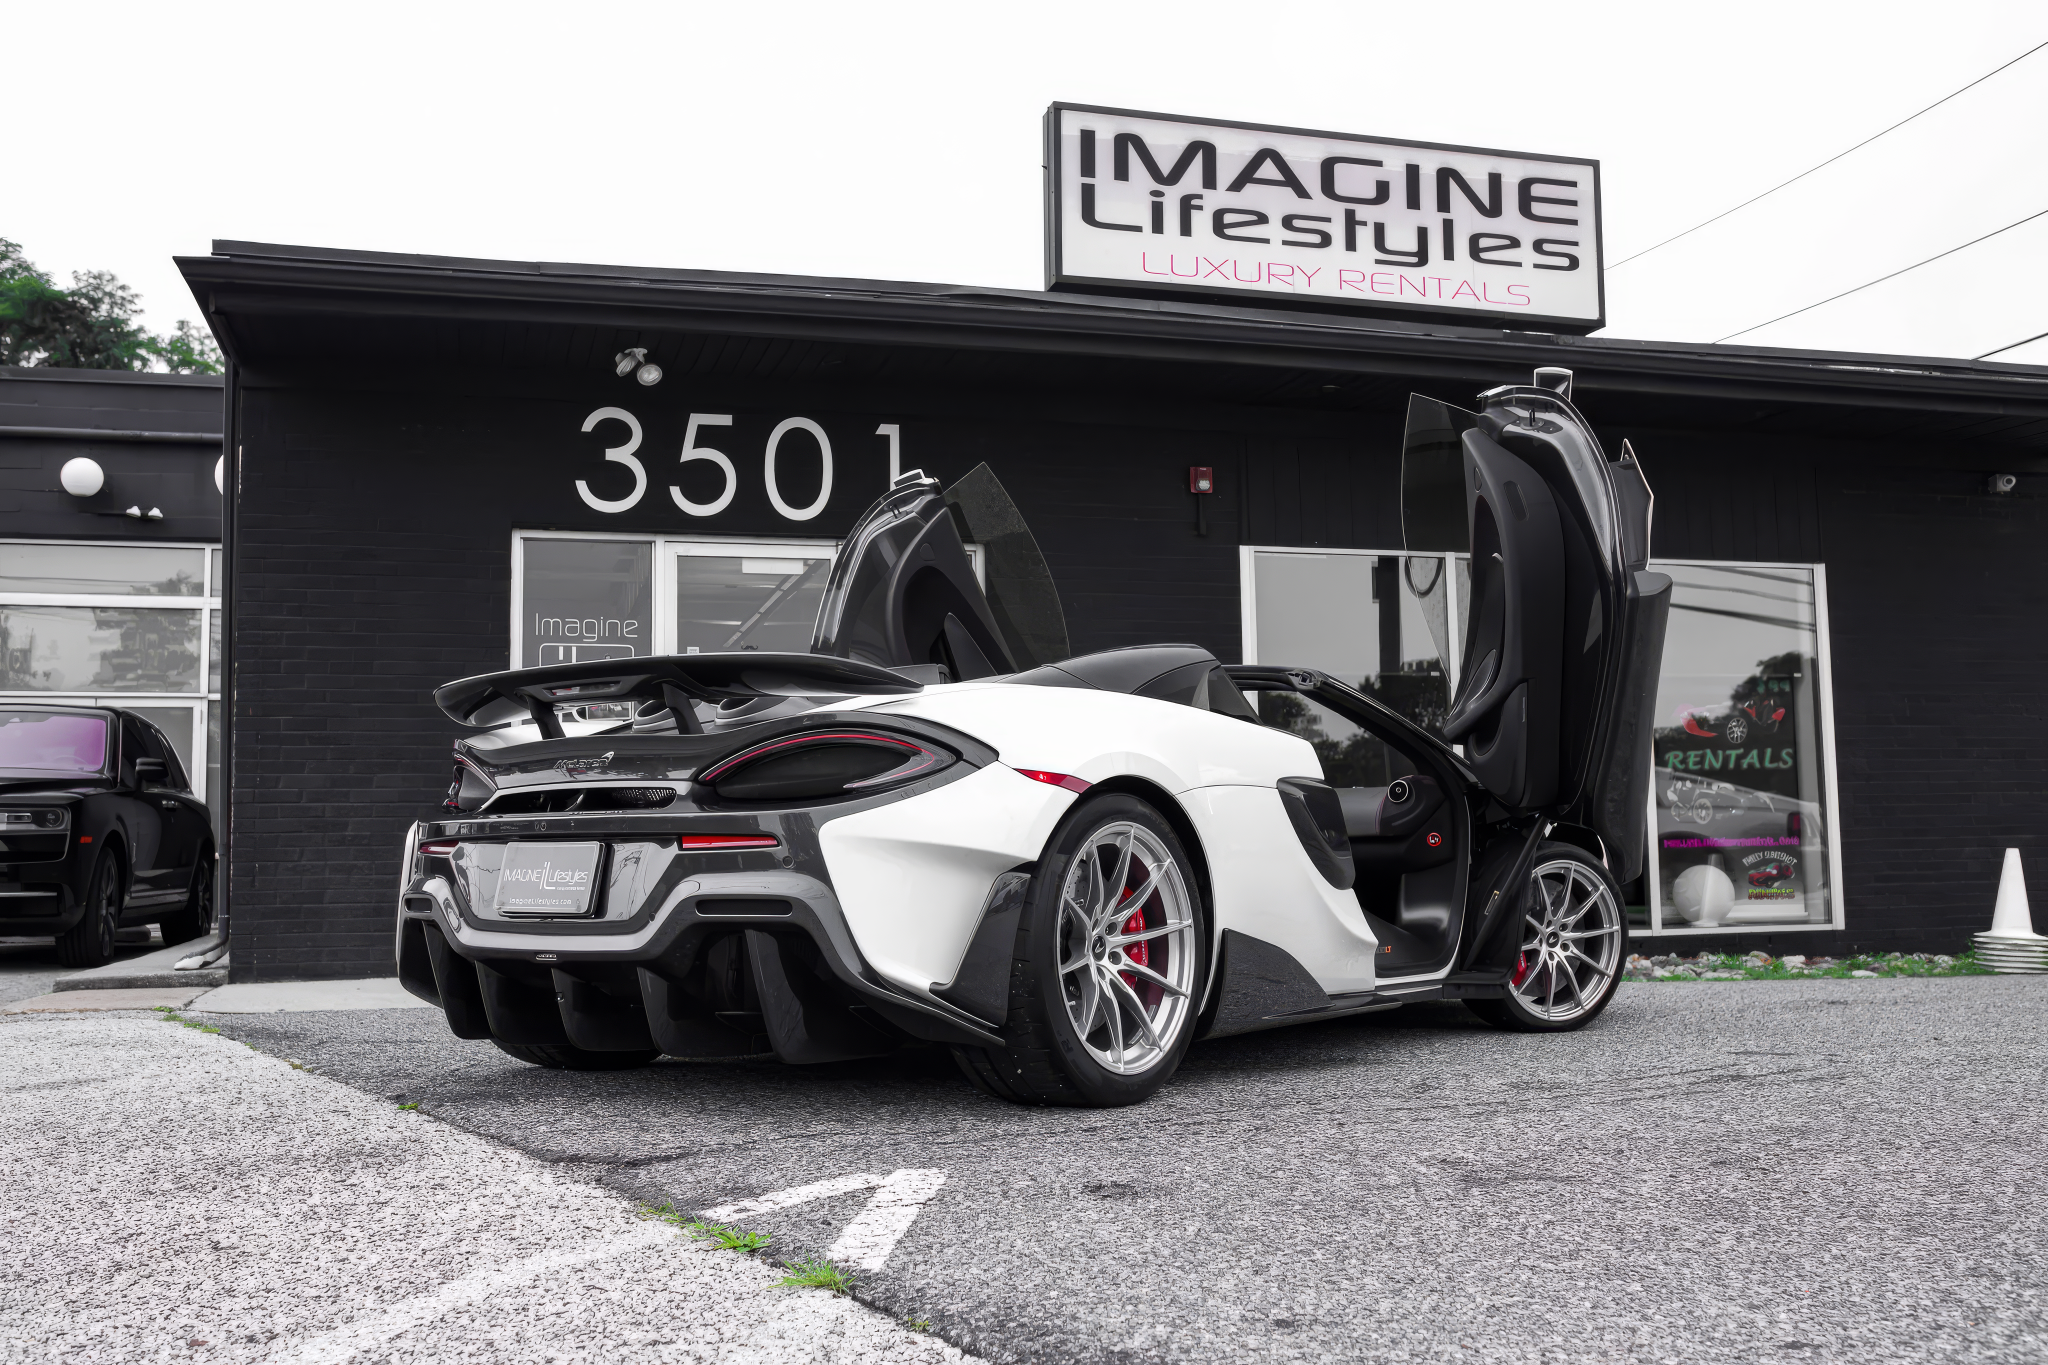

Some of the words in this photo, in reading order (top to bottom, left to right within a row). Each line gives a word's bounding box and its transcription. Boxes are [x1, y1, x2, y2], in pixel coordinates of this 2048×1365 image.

[1080, 129, 1579, 226] IMAGINE
[1081, 182, 1580, 272] Lifestyles
[1142, 251, 1322, 288] LUXURY
[1338, 268, 1532, 306] RENTALS
[575, 406, 901, 521] 3501
[535, 612, 638, 642] Imagine
[1665, 747, 1794, 769] RENTALS
